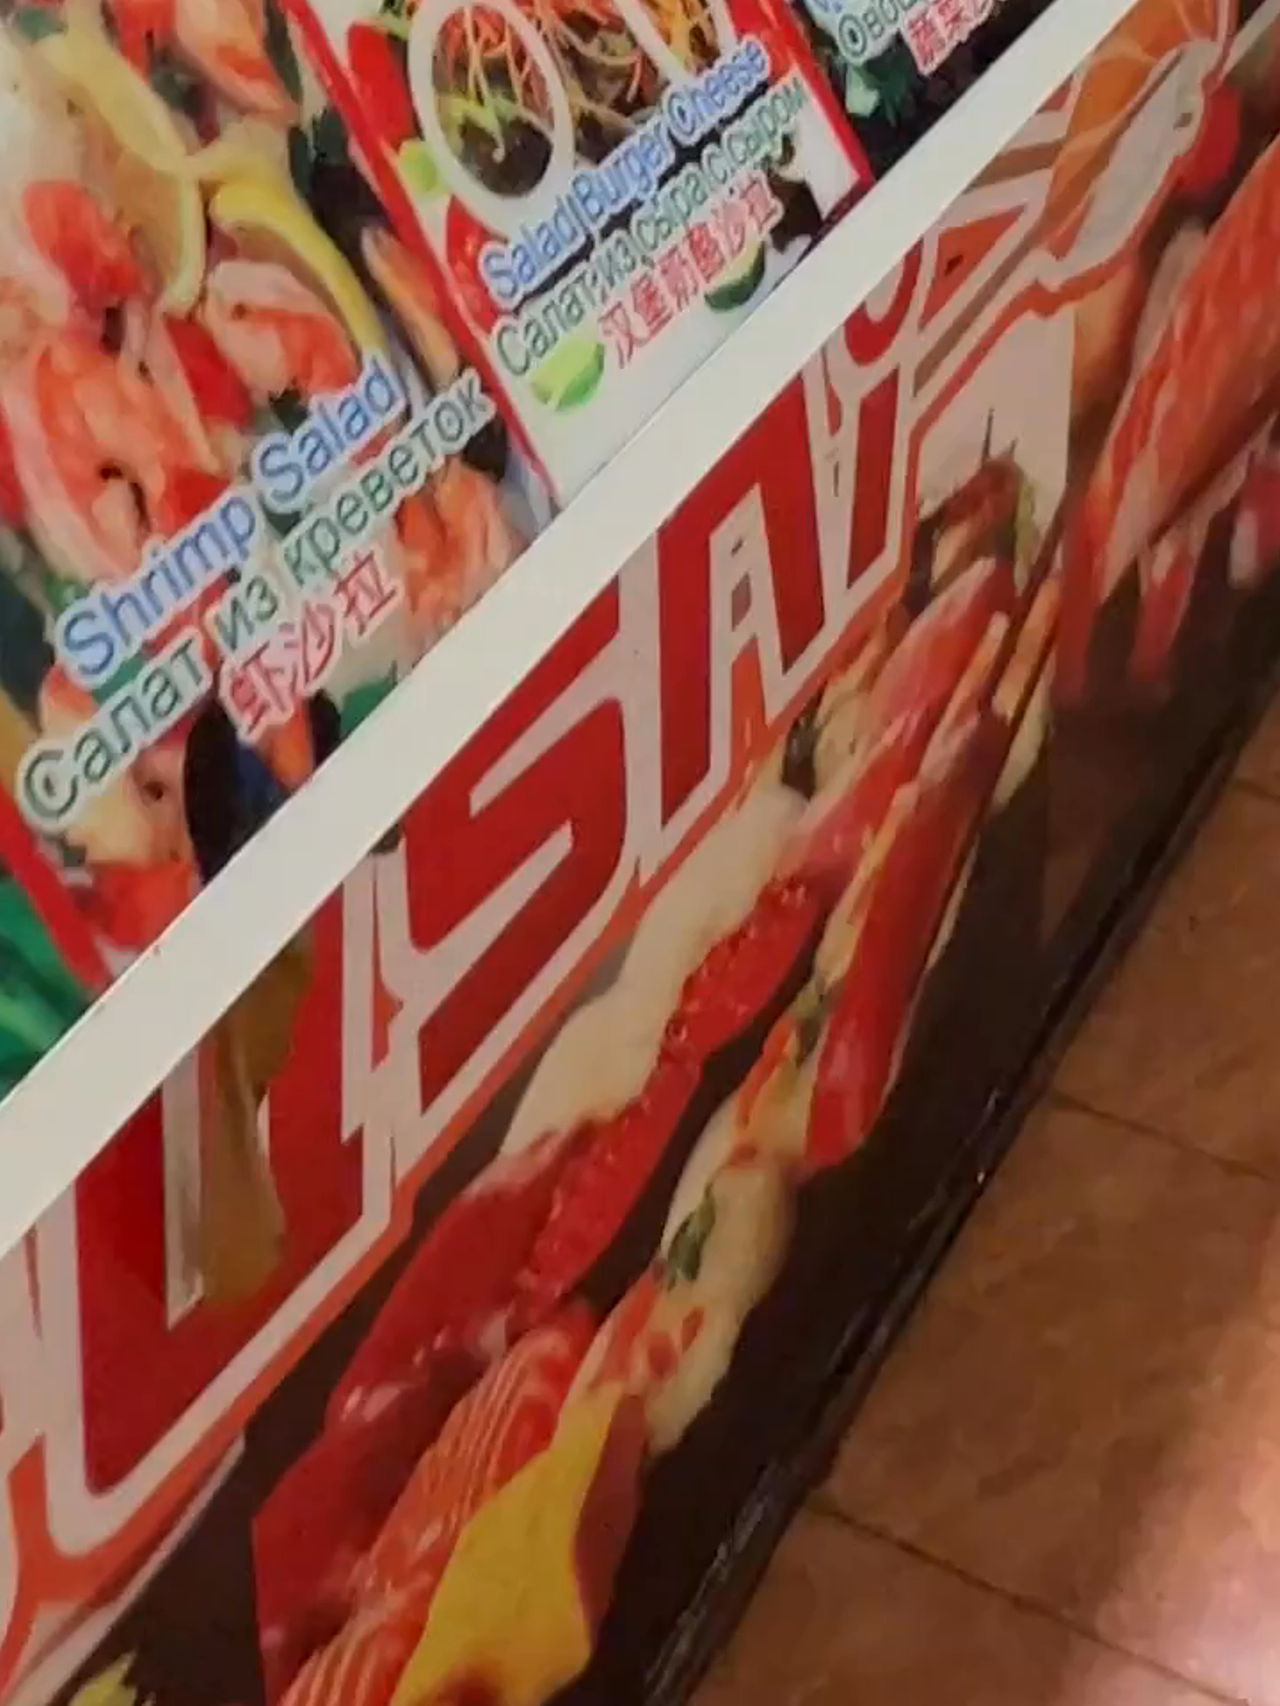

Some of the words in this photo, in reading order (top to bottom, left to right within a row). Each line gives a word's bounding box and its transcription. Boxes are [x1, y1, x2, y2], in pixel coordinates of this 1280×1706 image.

[23, 637, 208, 822] Салат
[213, 570, 280, 650] из
[283, 379, 492, 590] креветок
[60, 492, 258, 680] Shrimp
[256, 355, 402, 504] Salad
